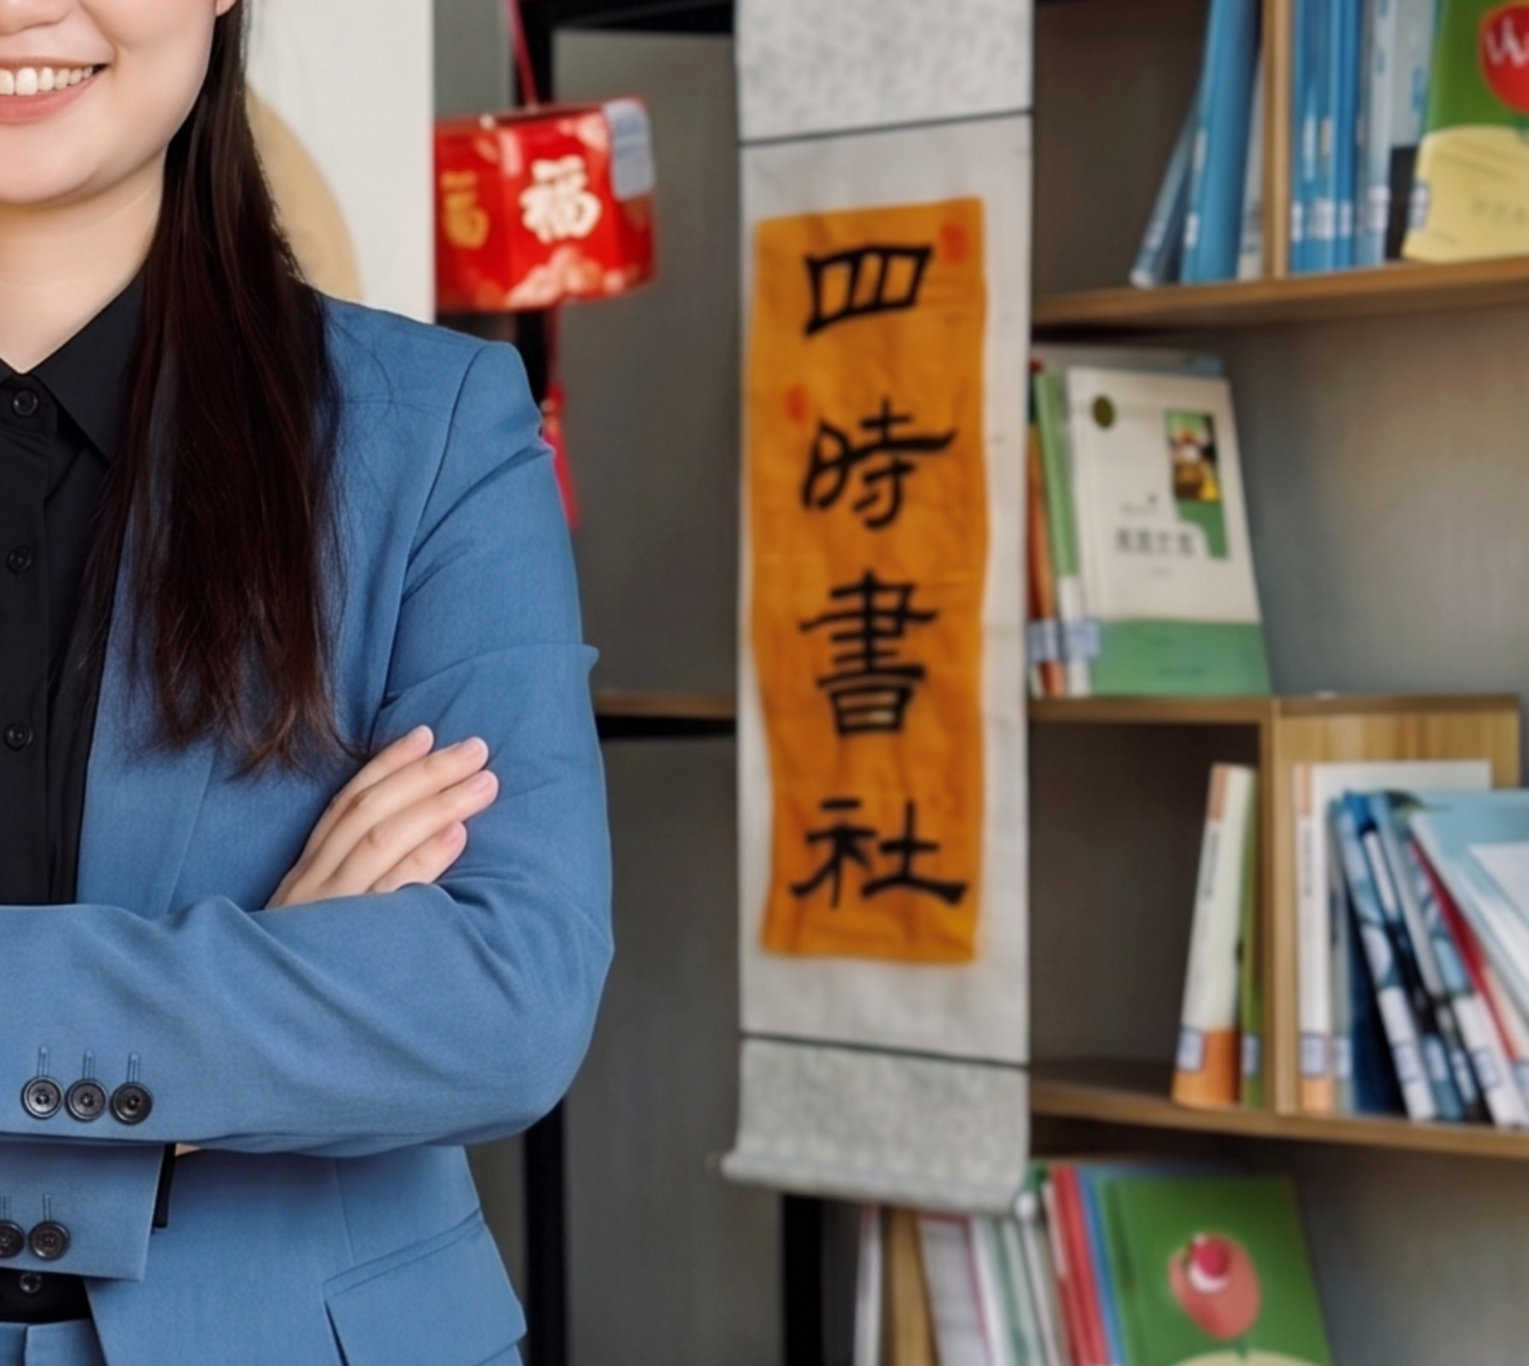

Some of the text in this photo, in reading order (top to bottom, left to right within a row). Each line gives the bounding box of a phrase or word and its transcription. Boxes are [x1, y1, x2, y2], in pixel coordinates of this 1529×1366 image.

[518, 155, 603, 245] 福
[789, 243, 968, 908] 四時書社
